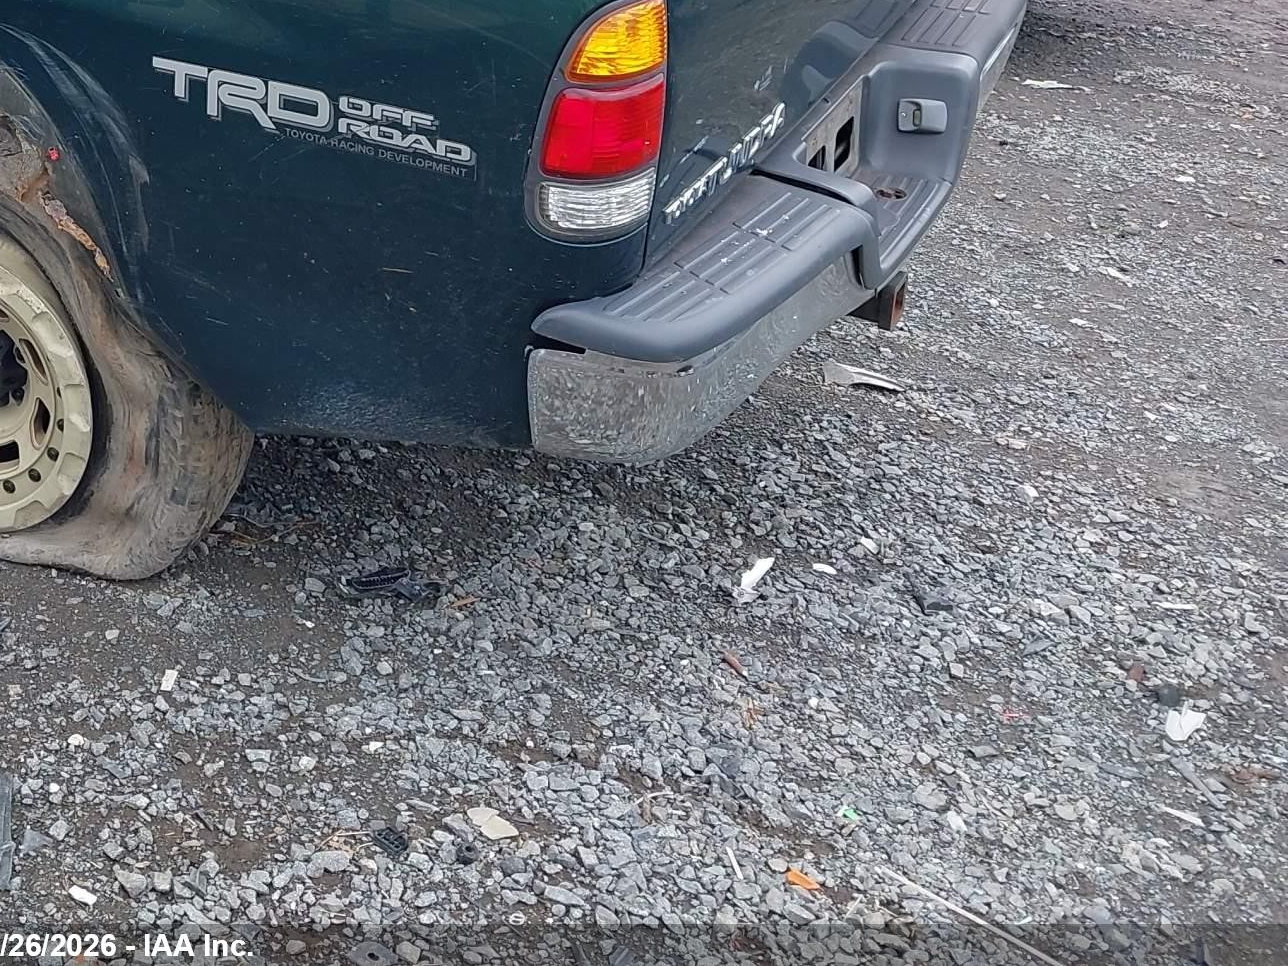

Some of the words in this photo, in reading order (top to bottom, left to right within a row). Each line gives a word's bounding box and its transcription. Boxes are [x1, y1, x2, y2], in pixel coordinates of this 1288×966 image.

[152, 56, 334, 134] TRD
[338, 95, 439, 130] OFF
[285, 127, 328, 146] TOYOTA
[330, 138, 375, 156] RACING
[378, 149, 468, 177] DEVELOPMENT
[337, 117, 477, 166] ROAD
